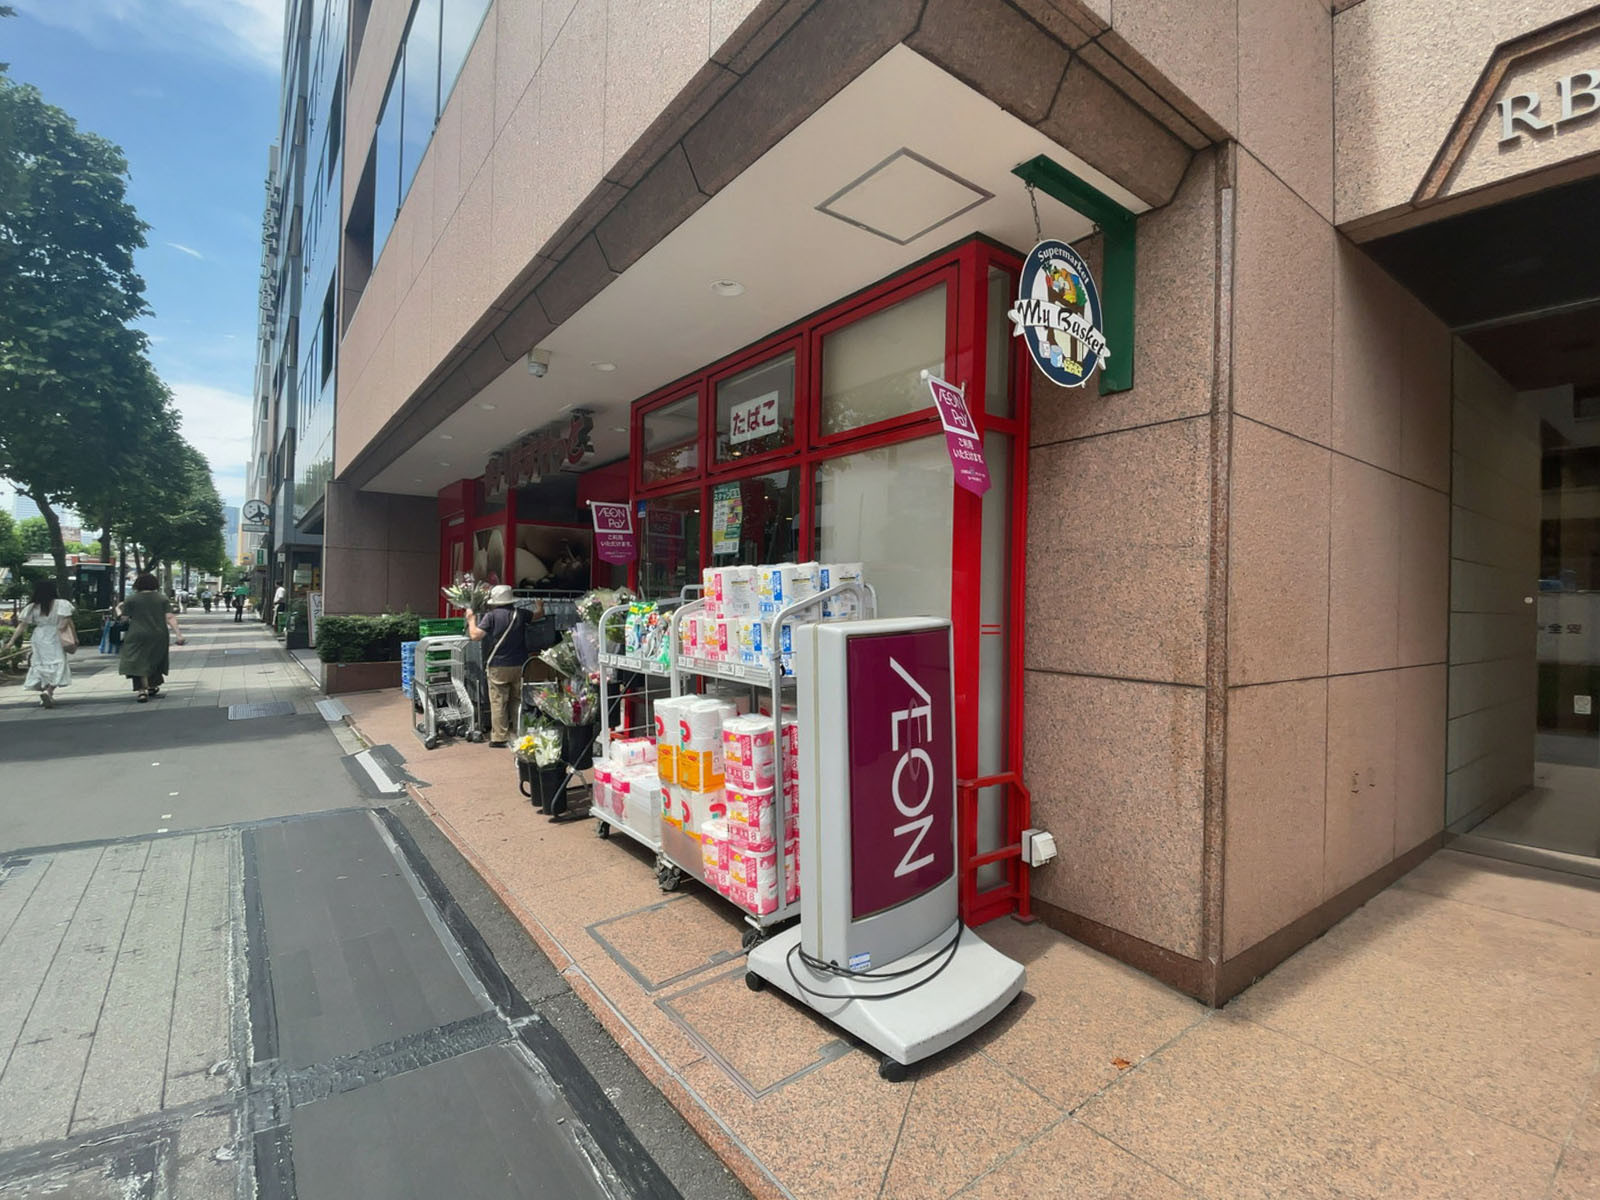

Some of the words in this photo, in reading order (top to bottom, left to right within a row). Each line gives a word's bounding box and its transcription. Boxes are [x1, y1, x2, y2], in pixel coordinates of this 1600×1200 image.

[1037, 246, 1089, 286] Supermarket
[1017, 299, 1050, 329] My
[1057, 307, 1105, 358] Basket
[732, 399, 776, 436] たばこ
[608, 518, 626, 529] Pay
